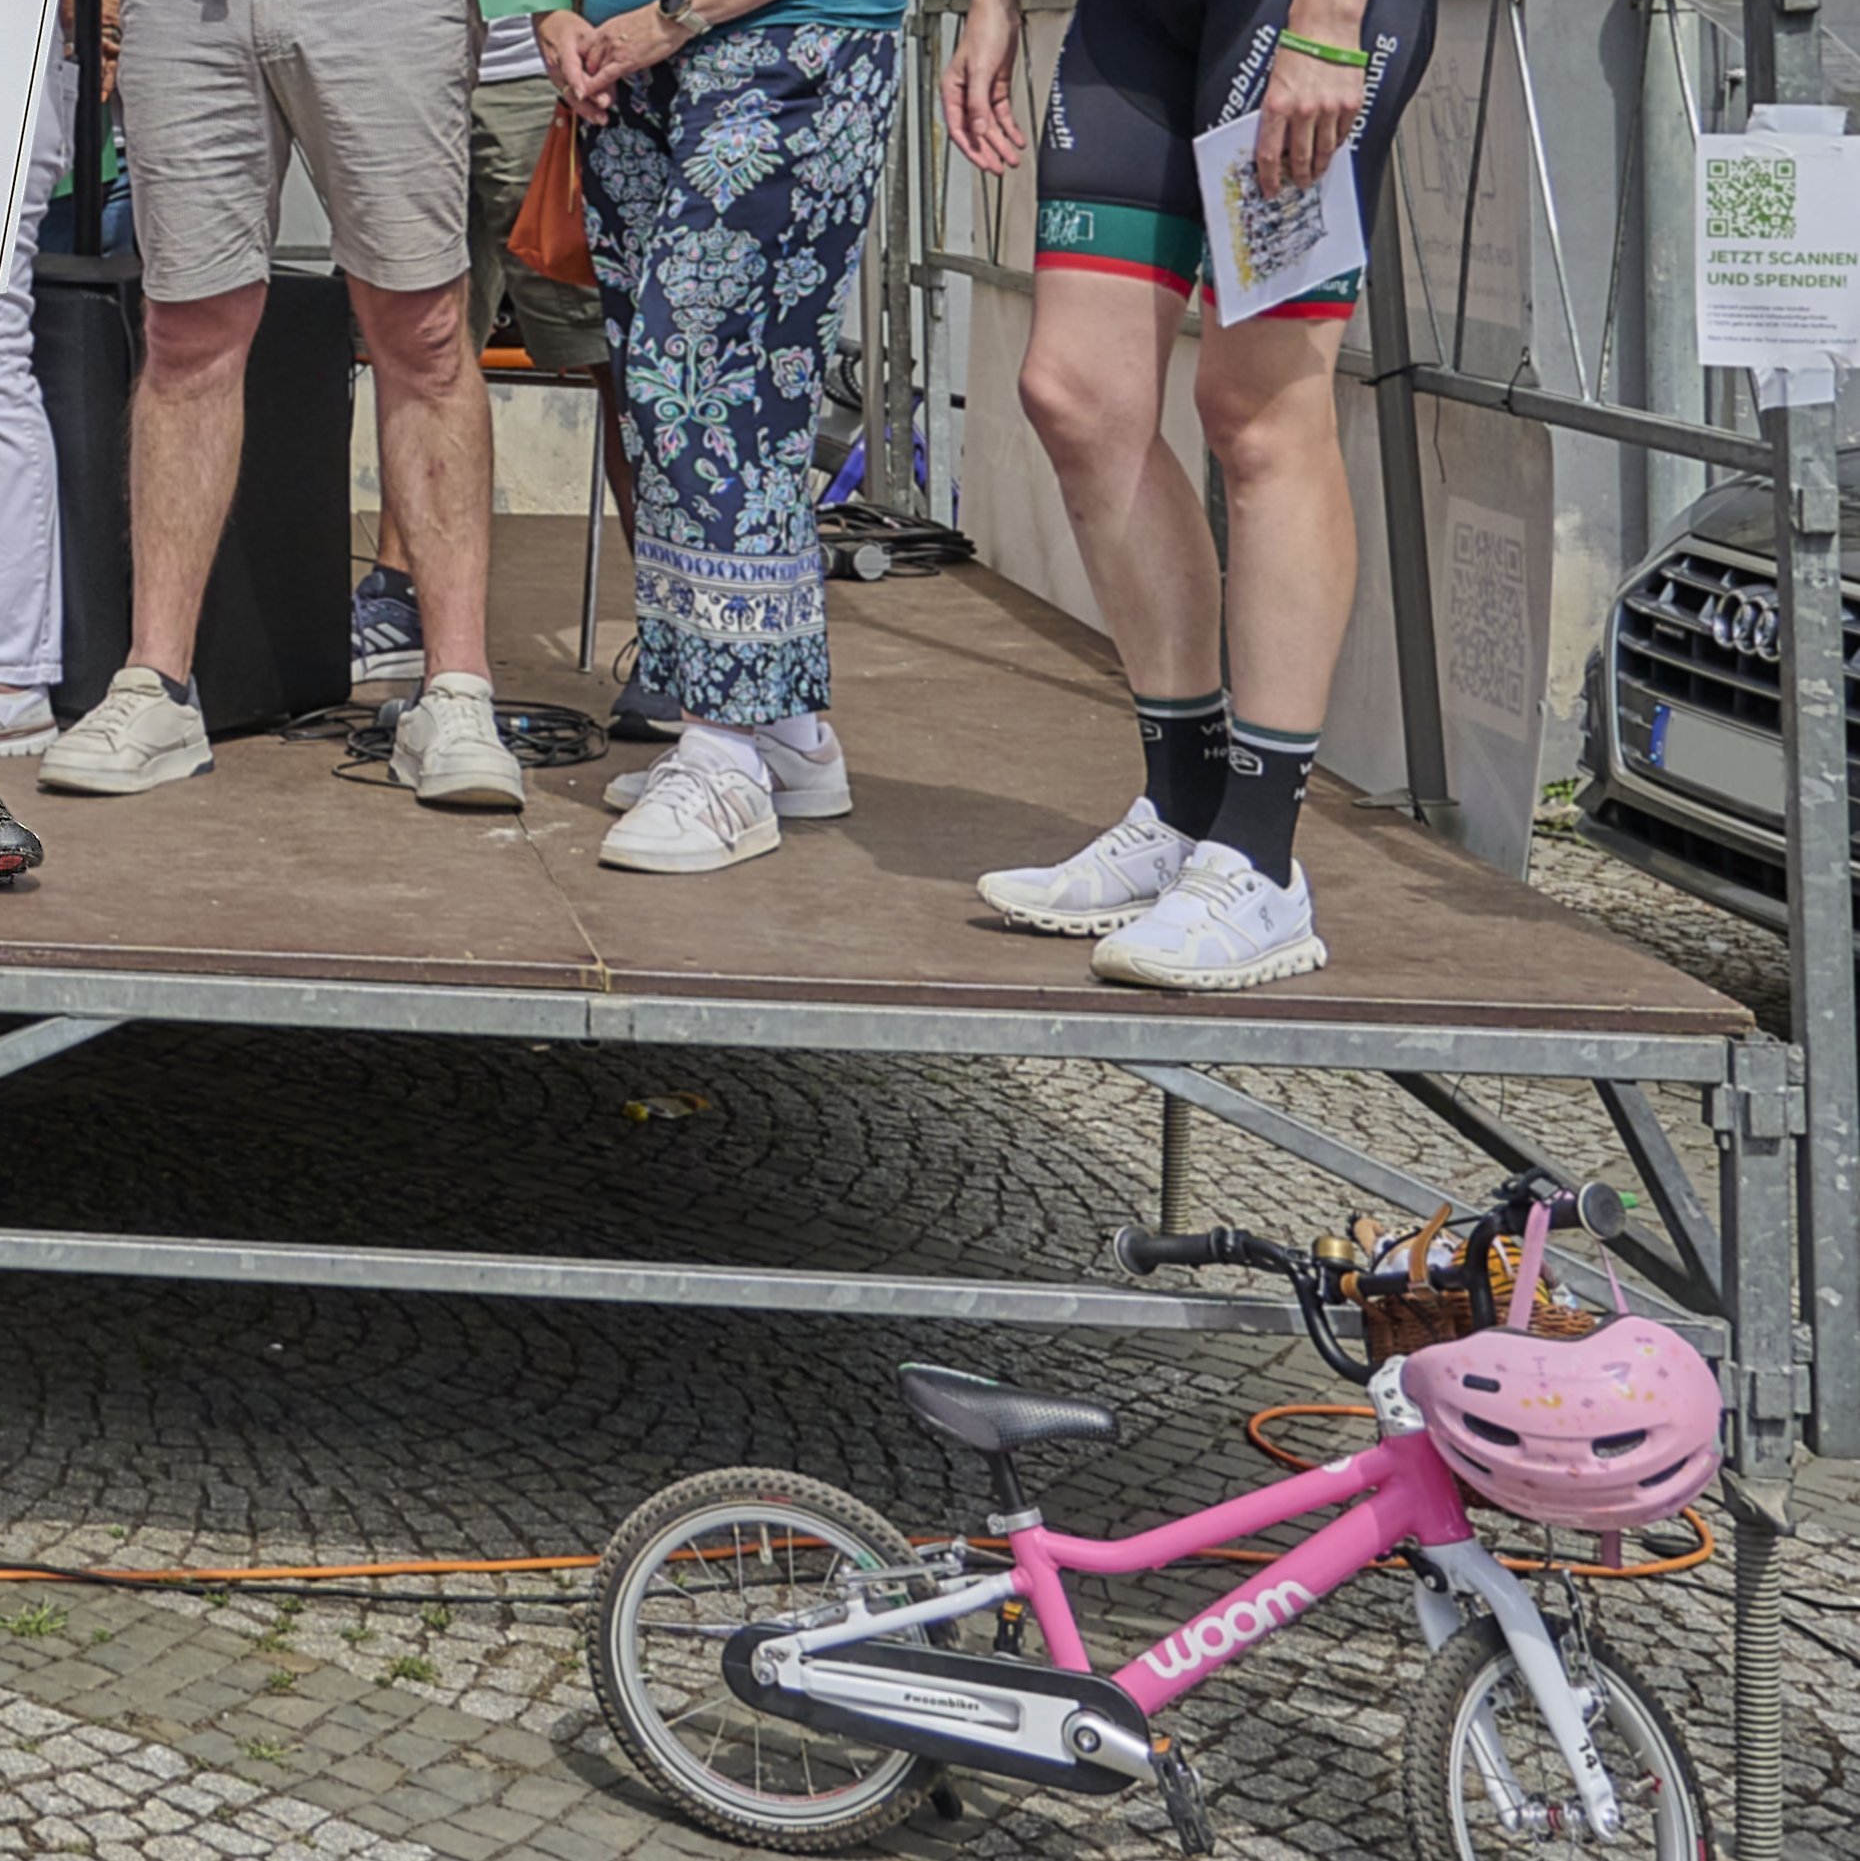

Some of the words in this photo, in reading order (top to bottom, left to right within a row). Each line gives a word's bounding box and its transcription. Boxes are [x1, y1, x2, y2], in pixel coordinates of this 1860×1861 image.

[1706, 249, 1764, 265] JETZT
[1768, 251, 1858, 266] SCANNEN
[1706, 271, 1750, 286] UND
[1753, 273, 1848, 288] SPENDEN!
[1137, 1577, 1318, 1681] woom
[1576, 1738, 1599, 1771] 14
